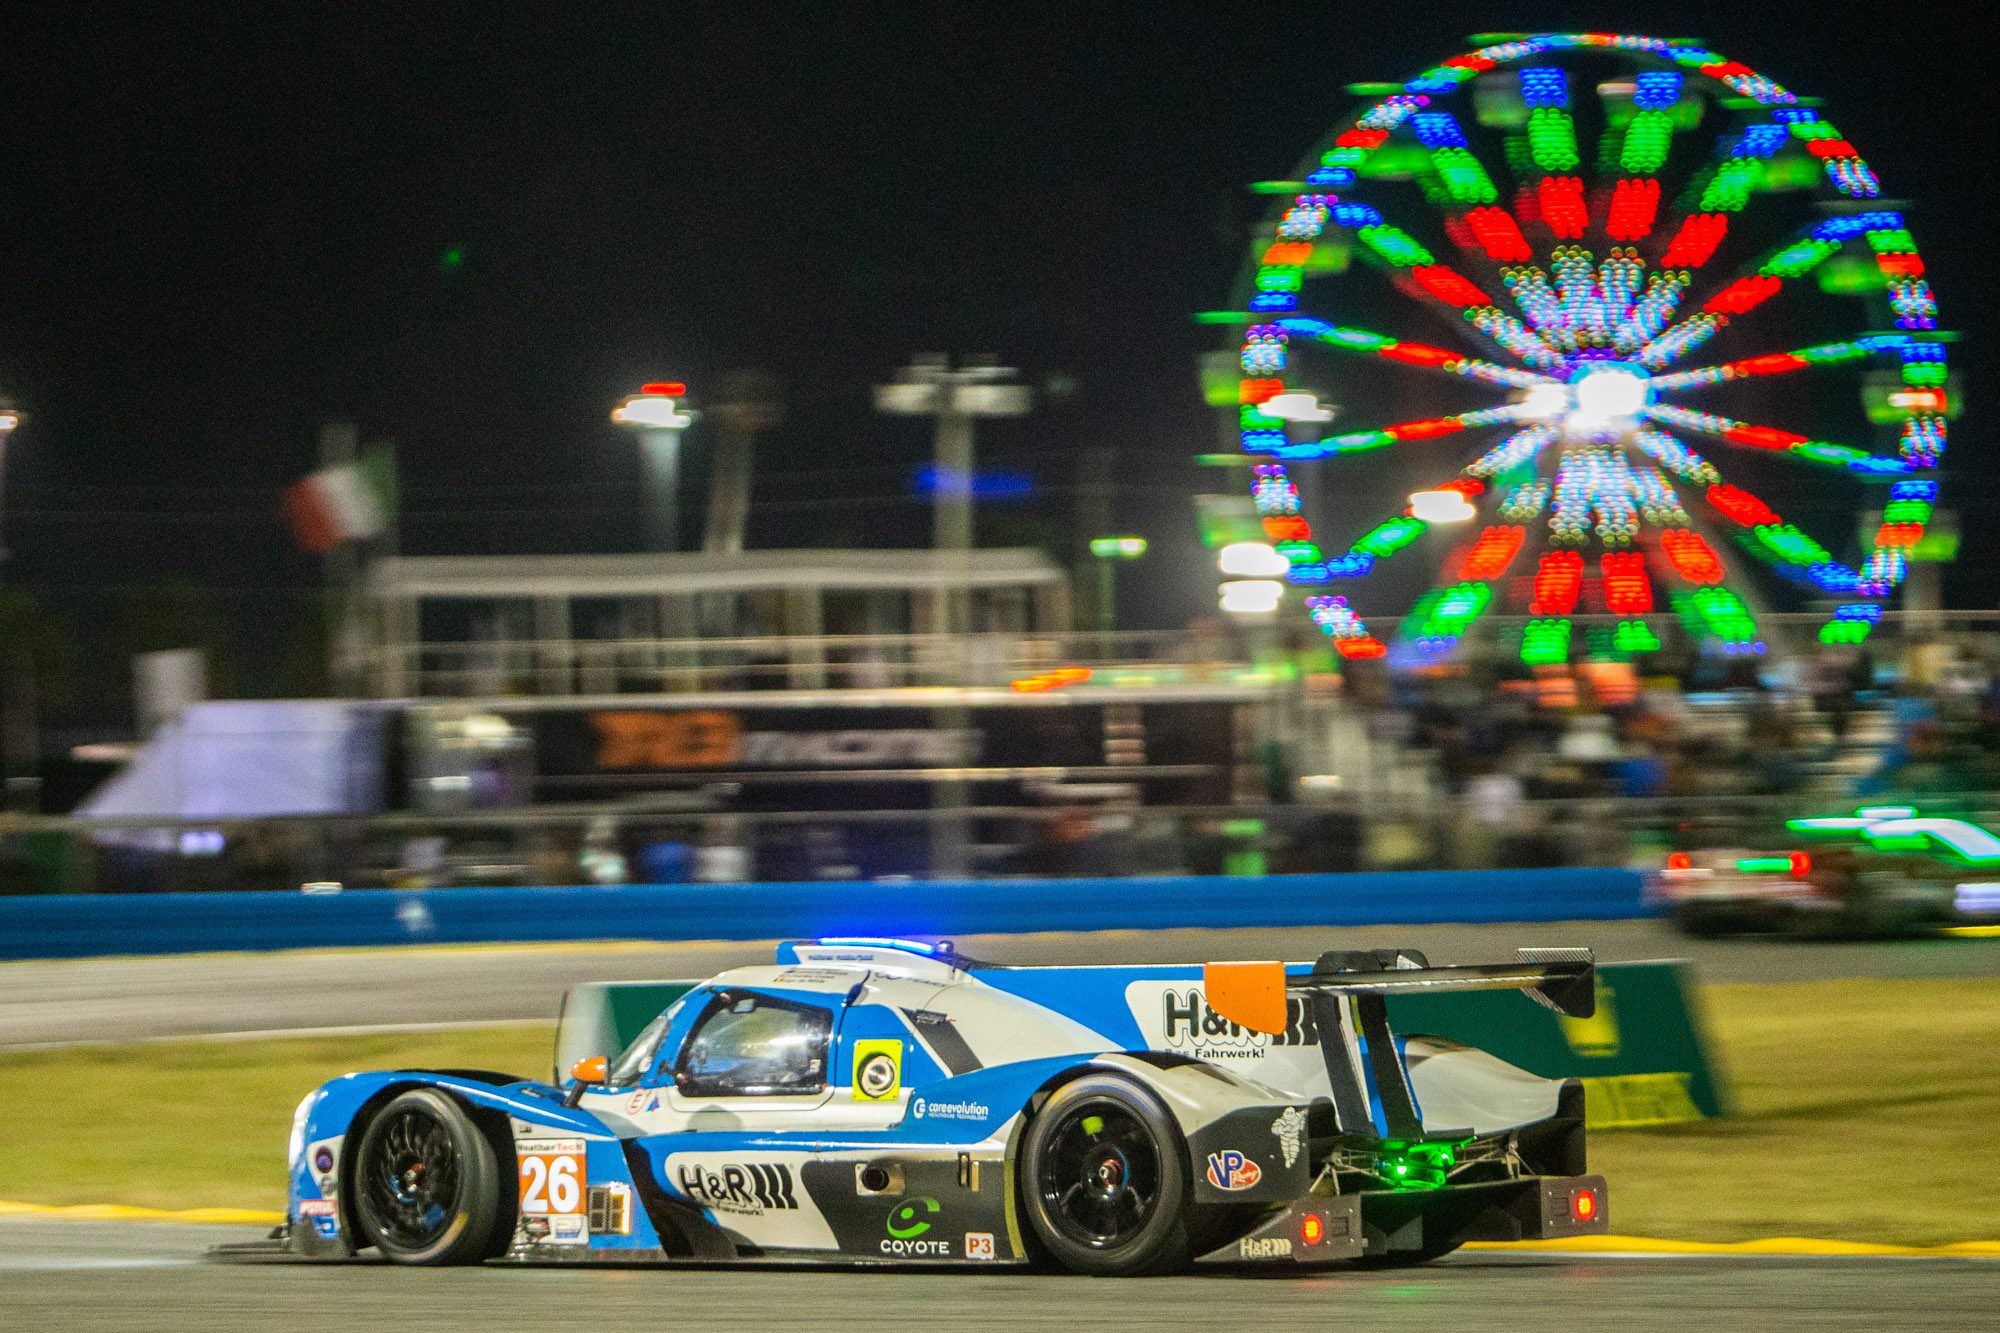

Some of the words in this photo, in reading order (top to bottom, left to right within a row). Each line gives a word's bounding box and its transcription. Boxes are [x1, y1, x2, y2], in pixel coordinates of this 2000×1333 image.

[1195, 1047, 1265, 1059] Fahrwerk!
[928, 1101, 988, 1115] careevolution
[1208, 1151, 1244, 1188] VP
[522, 1156, 580, 1212] 26
[881, 1240, 949, 1254] COYOTE
[969, 1238, 991, 1253] P3
